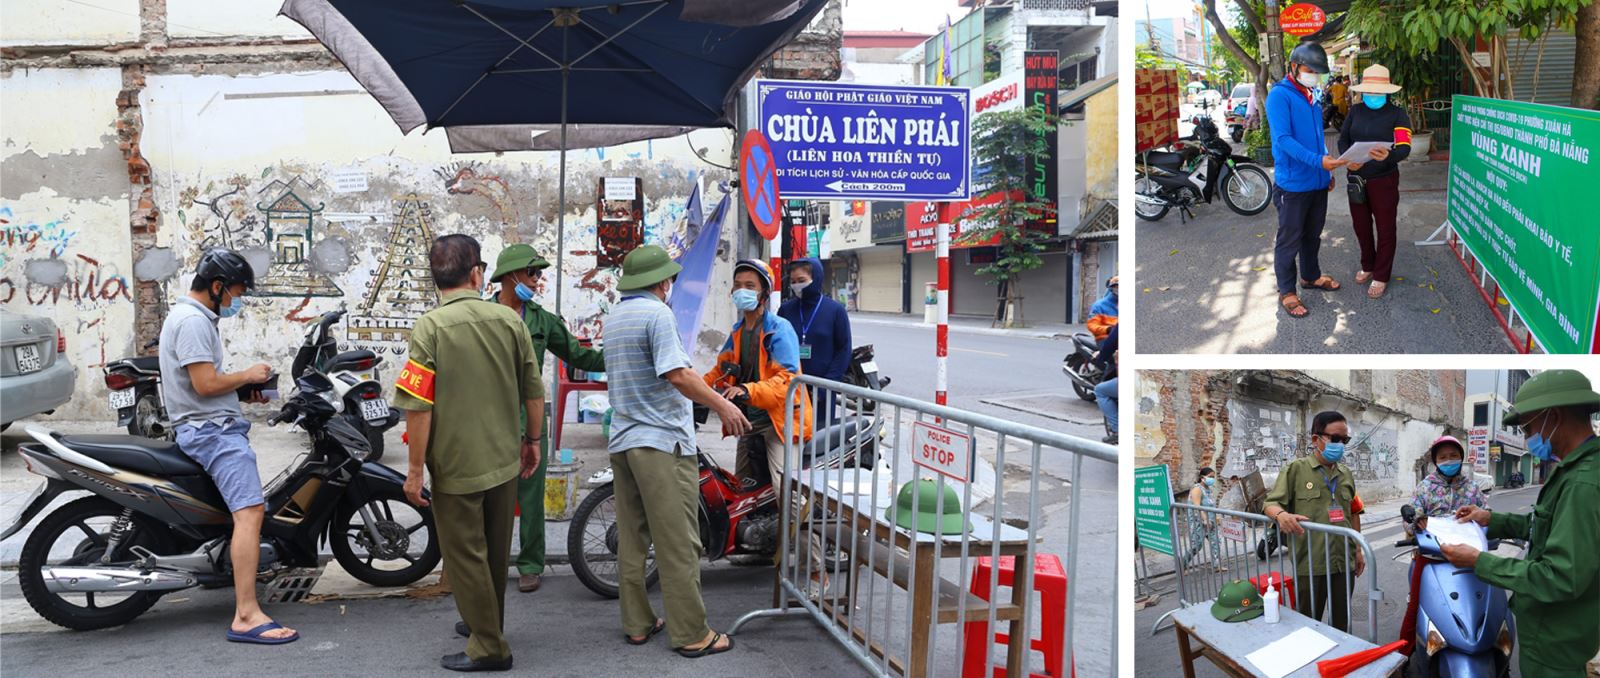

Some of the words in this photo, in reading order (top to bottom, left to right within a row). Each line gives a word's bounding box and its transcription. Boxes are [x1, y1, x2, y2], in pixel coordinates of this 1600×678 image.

[786, 90, 812, 100] GIÁO
[814, 90, 833, 102] HỘI
[836, 92, 864, 104] PHẬT
[867, 92, 892, 103] GIÁO
[896, 94, 918, 104] VIỆT
[921, 96, 943, 105] NAM
[976, 82, 1018, 112] BOSCH
[768, 107, 837, 144] CHÙA
[842, 109, 898, 145] LIÊN
[903, 112, 960, 146] PHÁI
[787, 148, 827, 162] (LIÊN
[832, 151, 862, 162] HOA
[917, 152, 942, 166] TỰ)
[1472, 130, 1498, 156] VÙNG
[1501, 142, 1542, 178] XANH
[1534, 132, 1549, 150] PHỐ
[1562, 139, 1589, 164] NẴNG
[787, 168, 808, 177] TÍCH
[810, 170, 830, 178] LỊCH
[832, 168, 844, 178] SỬ
[851, 168, 868, 178] VĂN
[891, 168, 908, 179] CẤP
[910, 169, 934, 180] QUỐC
[936, 172, 951, 180] GIA
[1525, 216, 1539, 236] KHAI
[1540, 228, 1554, 248] BÁO
[1555, 240, 1560, 253] Y
[1546, 298, 1557, 320] GIA
[1558, 312, 1580, 344] ĐÌNH
[410, 374, 422, 390] VỆ
[928, 430, 951, 445] POLICE
[923, 444, 955, 466] STOP
